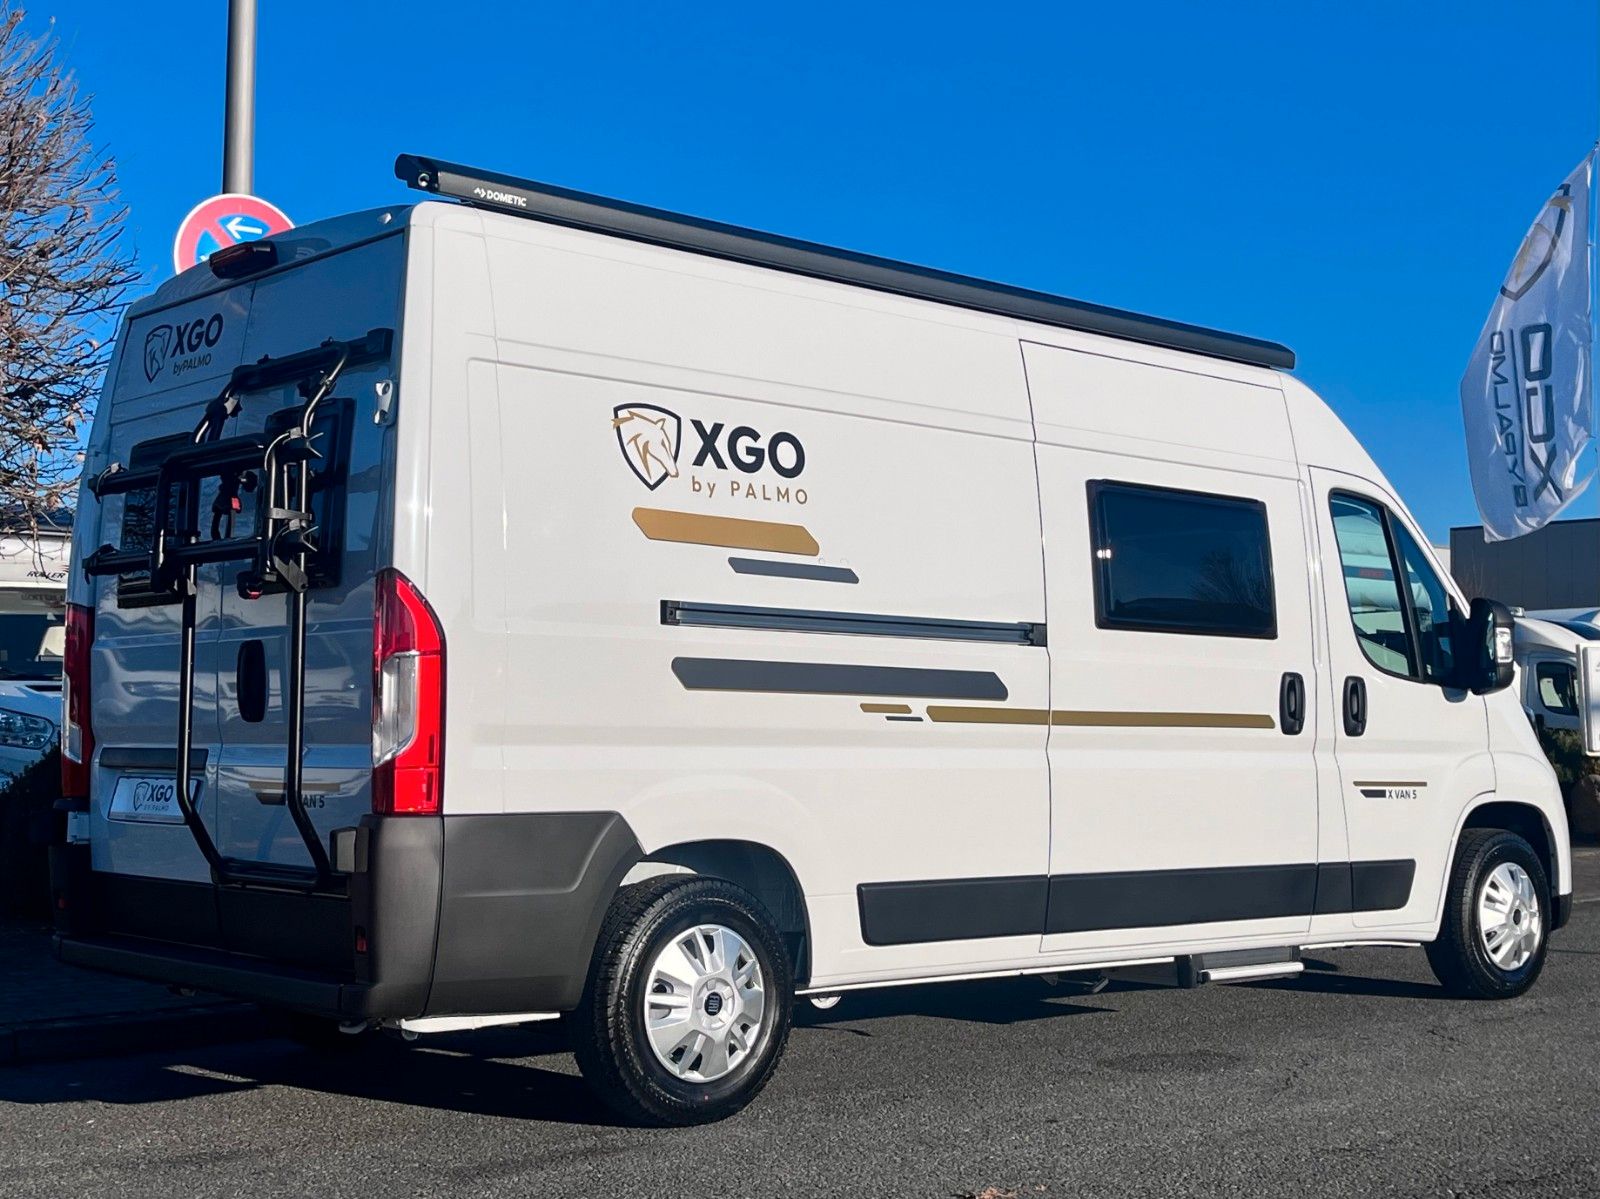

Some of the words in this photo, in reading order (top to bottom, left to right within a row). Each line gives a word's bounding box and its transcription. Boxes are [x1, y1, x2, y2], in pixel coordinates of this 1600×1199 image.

[486, 189, 527, 207] DOMETIC
[170, 313, 224, 358] XGO
[690, 418, 806, 479] XGO
[691, 475, 716, 498] by
[730, 480, 808, 504] PALMO
[147, 784, 174, 802] XGO
[318, 795, 325, 808] 5
[1387, 789, 1393, 799] X
[1394, 789, 1411, 799] VAN
